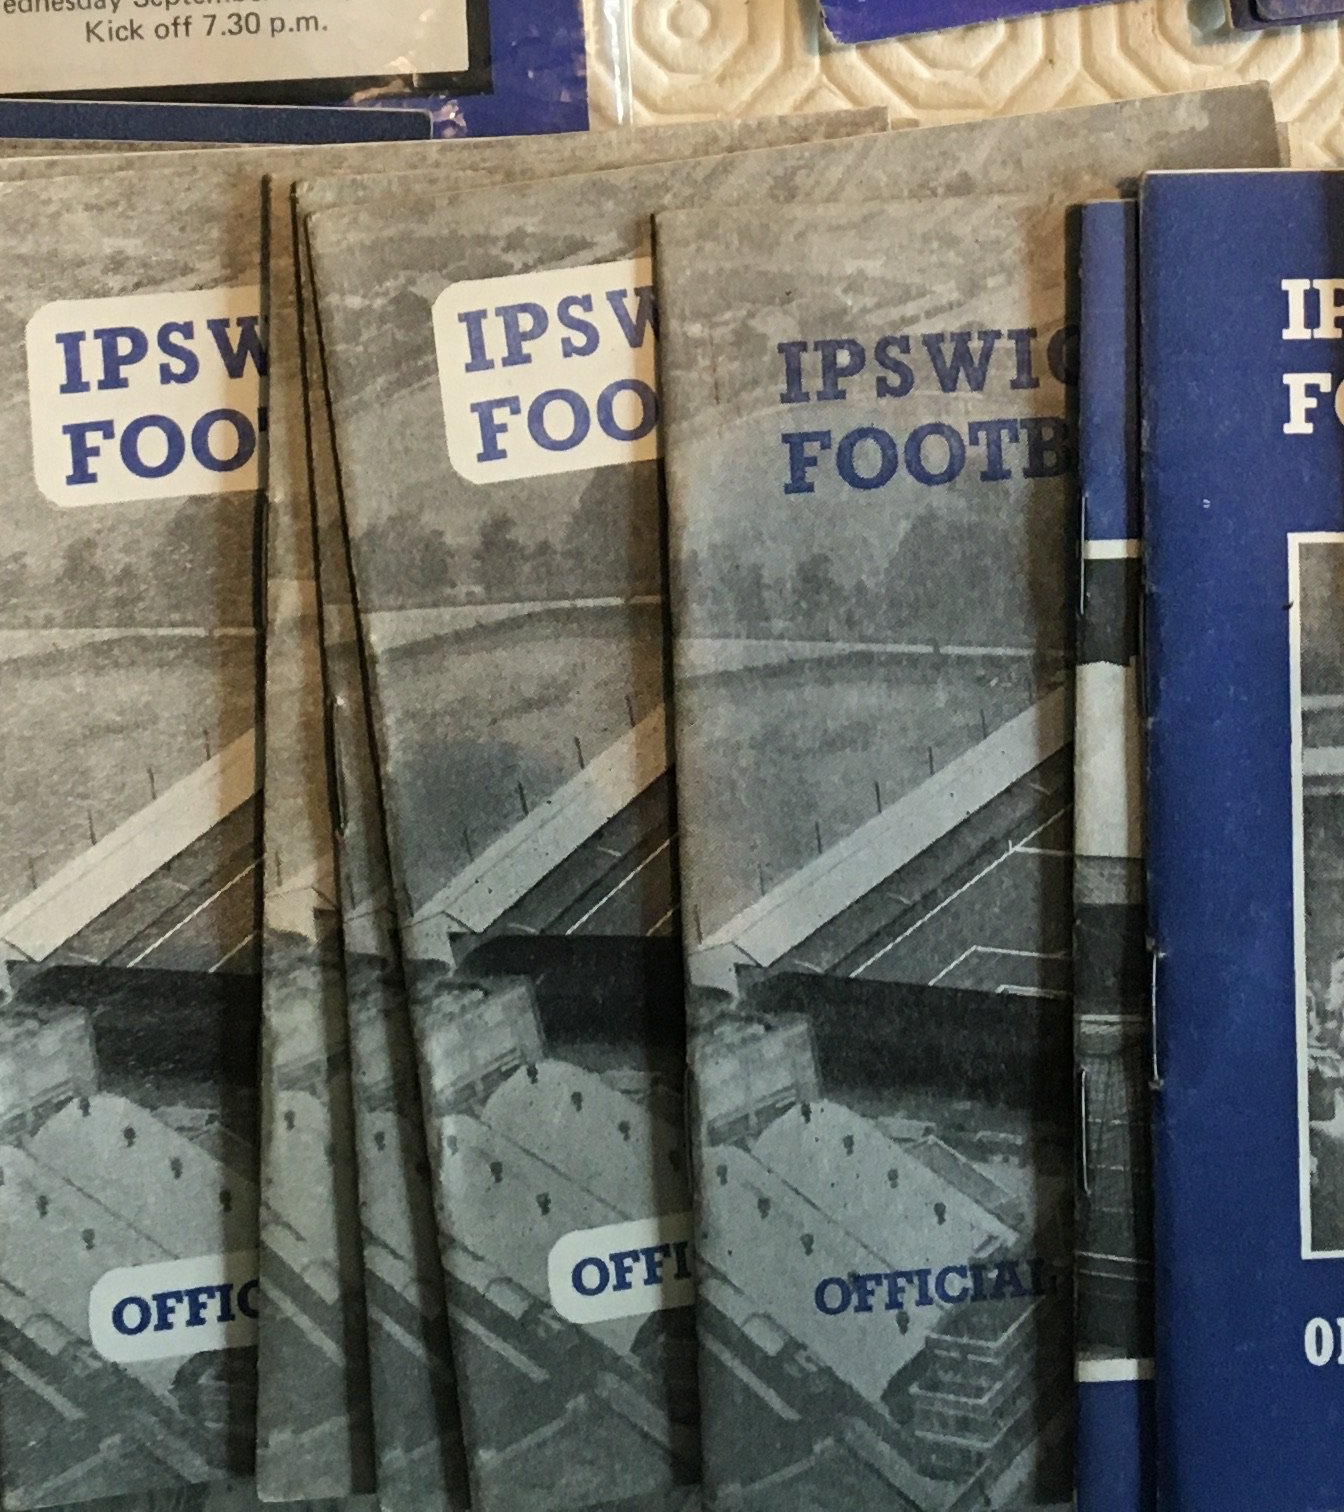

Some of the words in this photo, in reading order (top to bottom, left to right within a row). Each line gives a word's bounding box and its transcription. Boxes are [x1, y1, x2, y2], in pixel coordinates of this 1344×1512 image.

[84, 18, 145, 44] Kick
[154, 14, 193, 40] off
[202, 12, 261, 38] 7.30
[269, 14, 329, 39] p.m.
[63, 408, 267, 486] FOO
